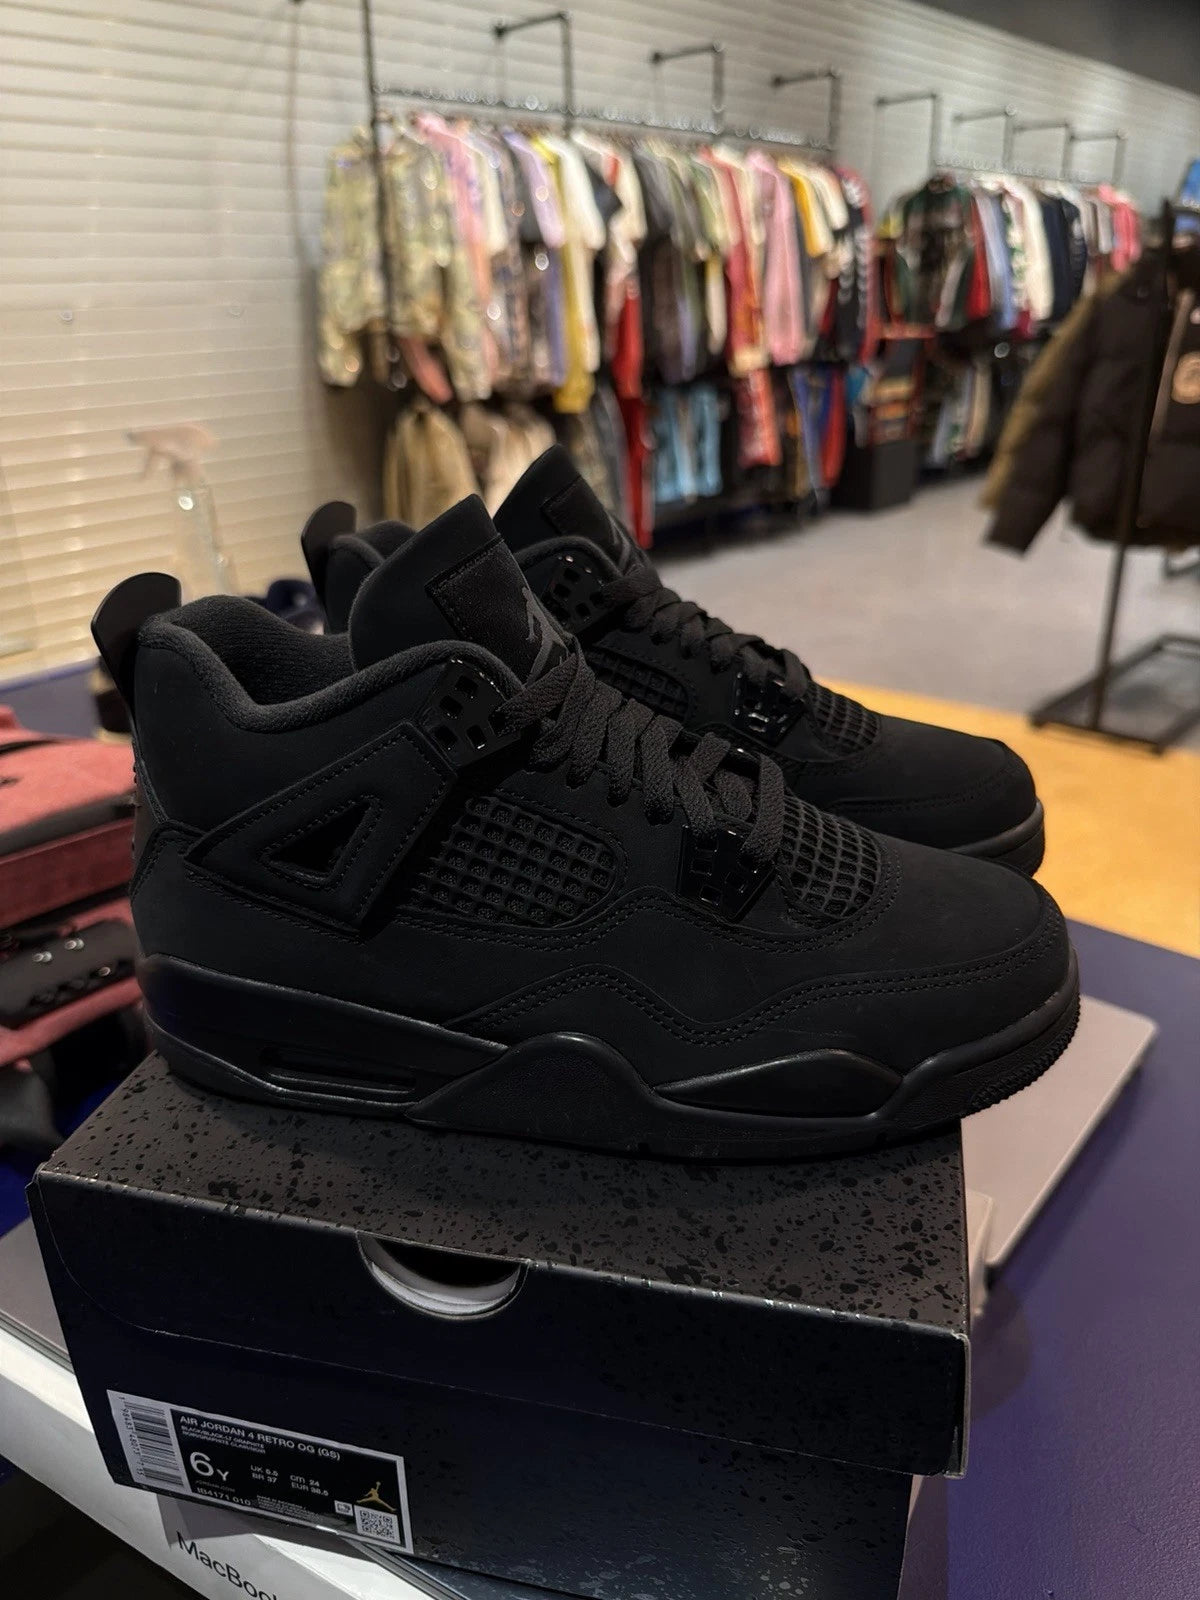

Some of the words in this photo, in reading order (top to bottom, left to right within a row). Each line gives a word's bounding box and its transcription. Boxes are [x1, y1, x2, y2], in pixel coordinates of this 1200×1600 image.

[180, 1416, 198, 1426] AIR
[200, 1420, 245, 1437] JORDAN
[247, 1431, 255, 1440] 4
[257, 1434, 295, 1449] RETRO
[297, 1442, 315, 1454] OG
[318, 1447, 341, 1461] (GS)
[250, 1464, 263, 1472] UK
[251, 1472, 264, 1481] BR
[267, 1475, 278, 1484] 37
[309, 1479, 320, 1487] 24
[291, 1481, 309, 1492] EUR
[176, 1530, 277, 1600] MacBoo
